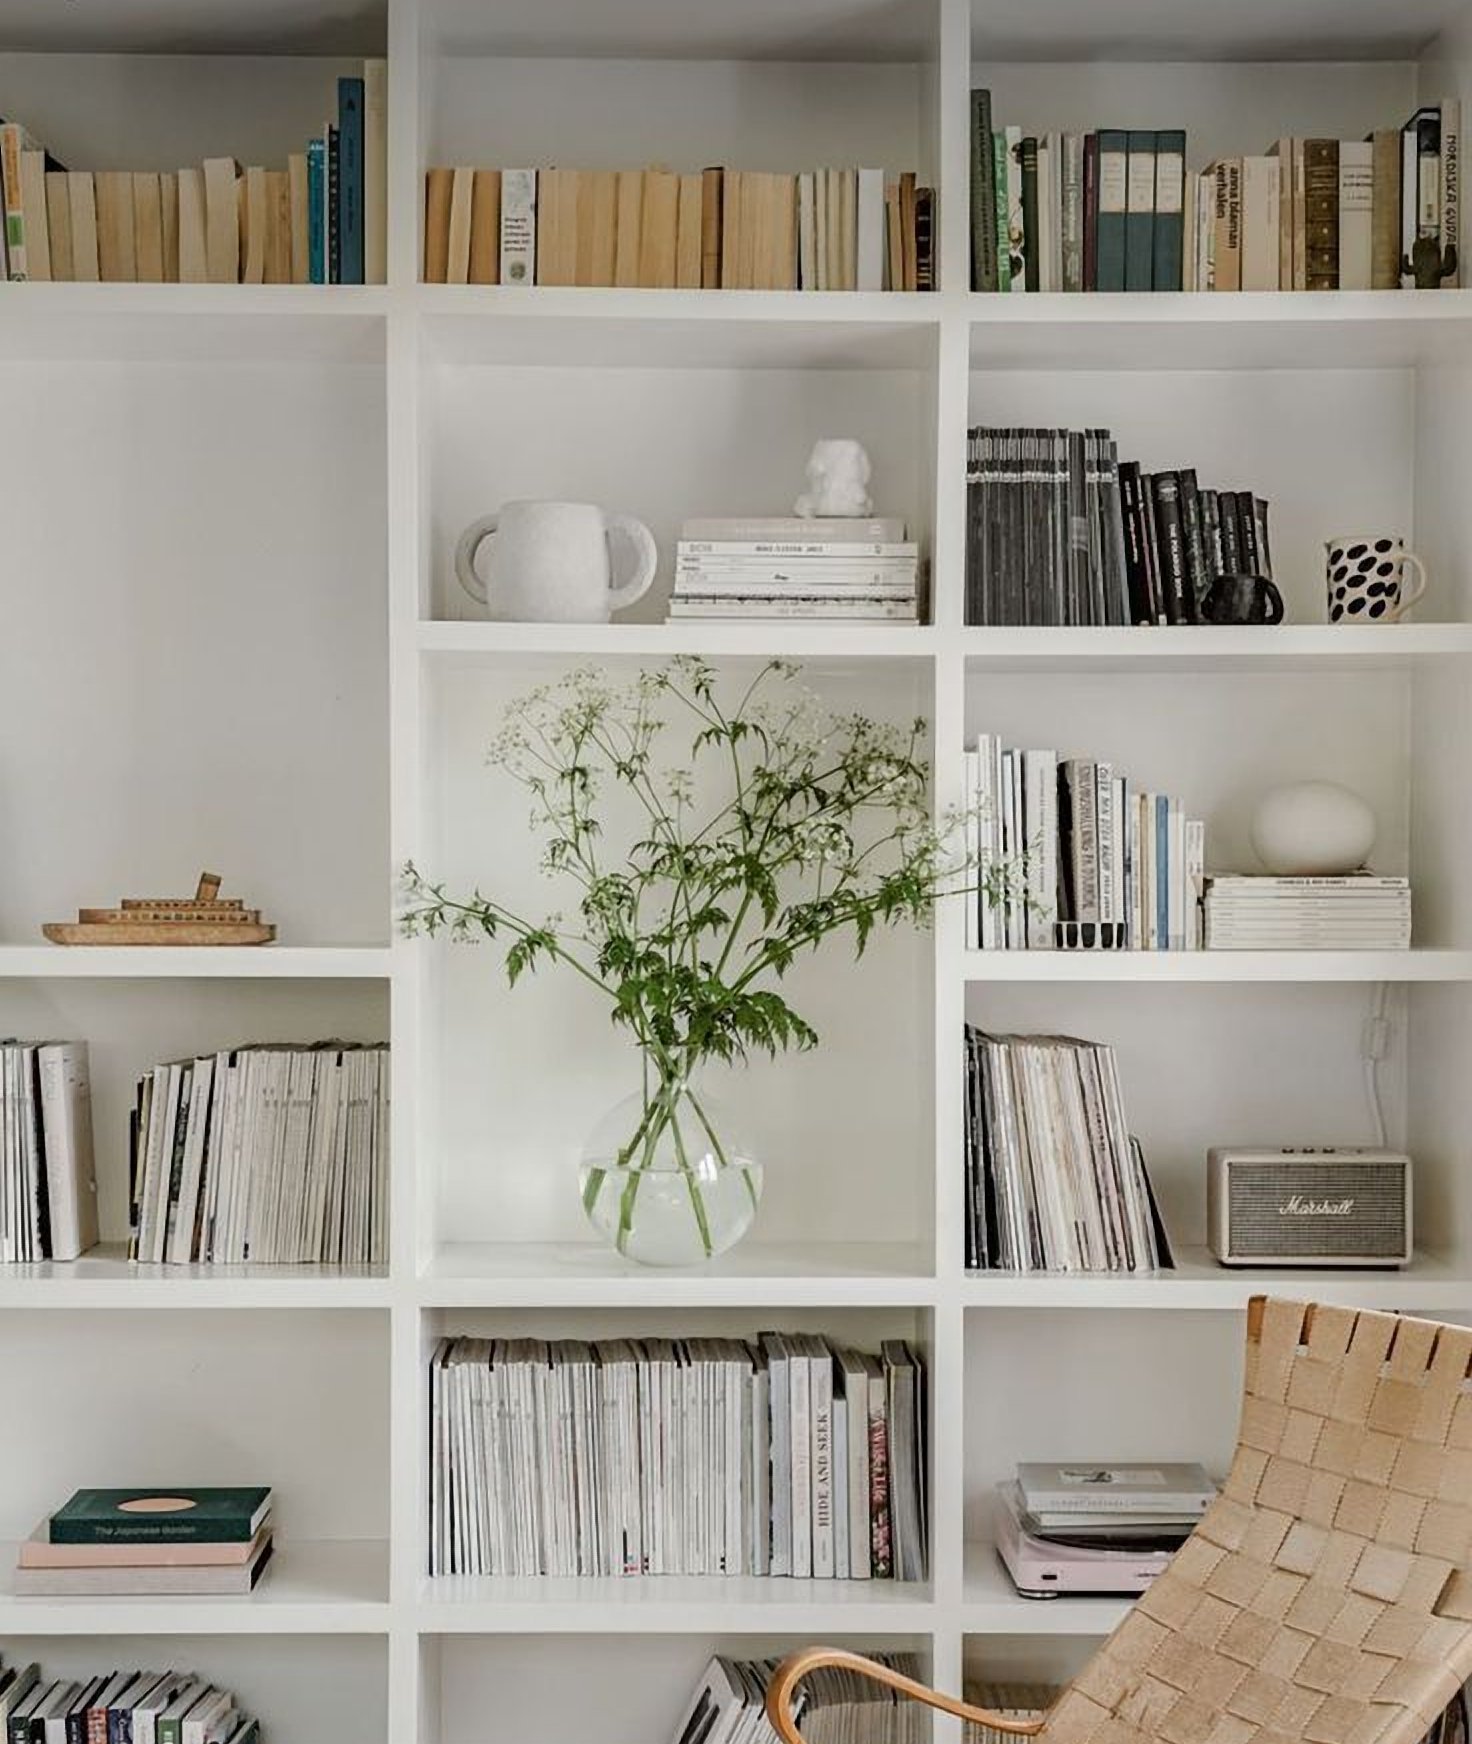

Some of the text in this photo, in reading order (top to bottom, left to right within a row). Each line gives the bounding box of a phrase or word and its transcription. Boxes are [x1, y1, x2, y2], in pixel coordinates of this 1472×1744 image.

[1217, 163, 1228, 219] verhalen
[1228, 167, 1240, 249] anna blaman
[1279, 1195, 1355, 1215] Marshall
[816, 1413, 830, 1527] HIDE AND SEEK
